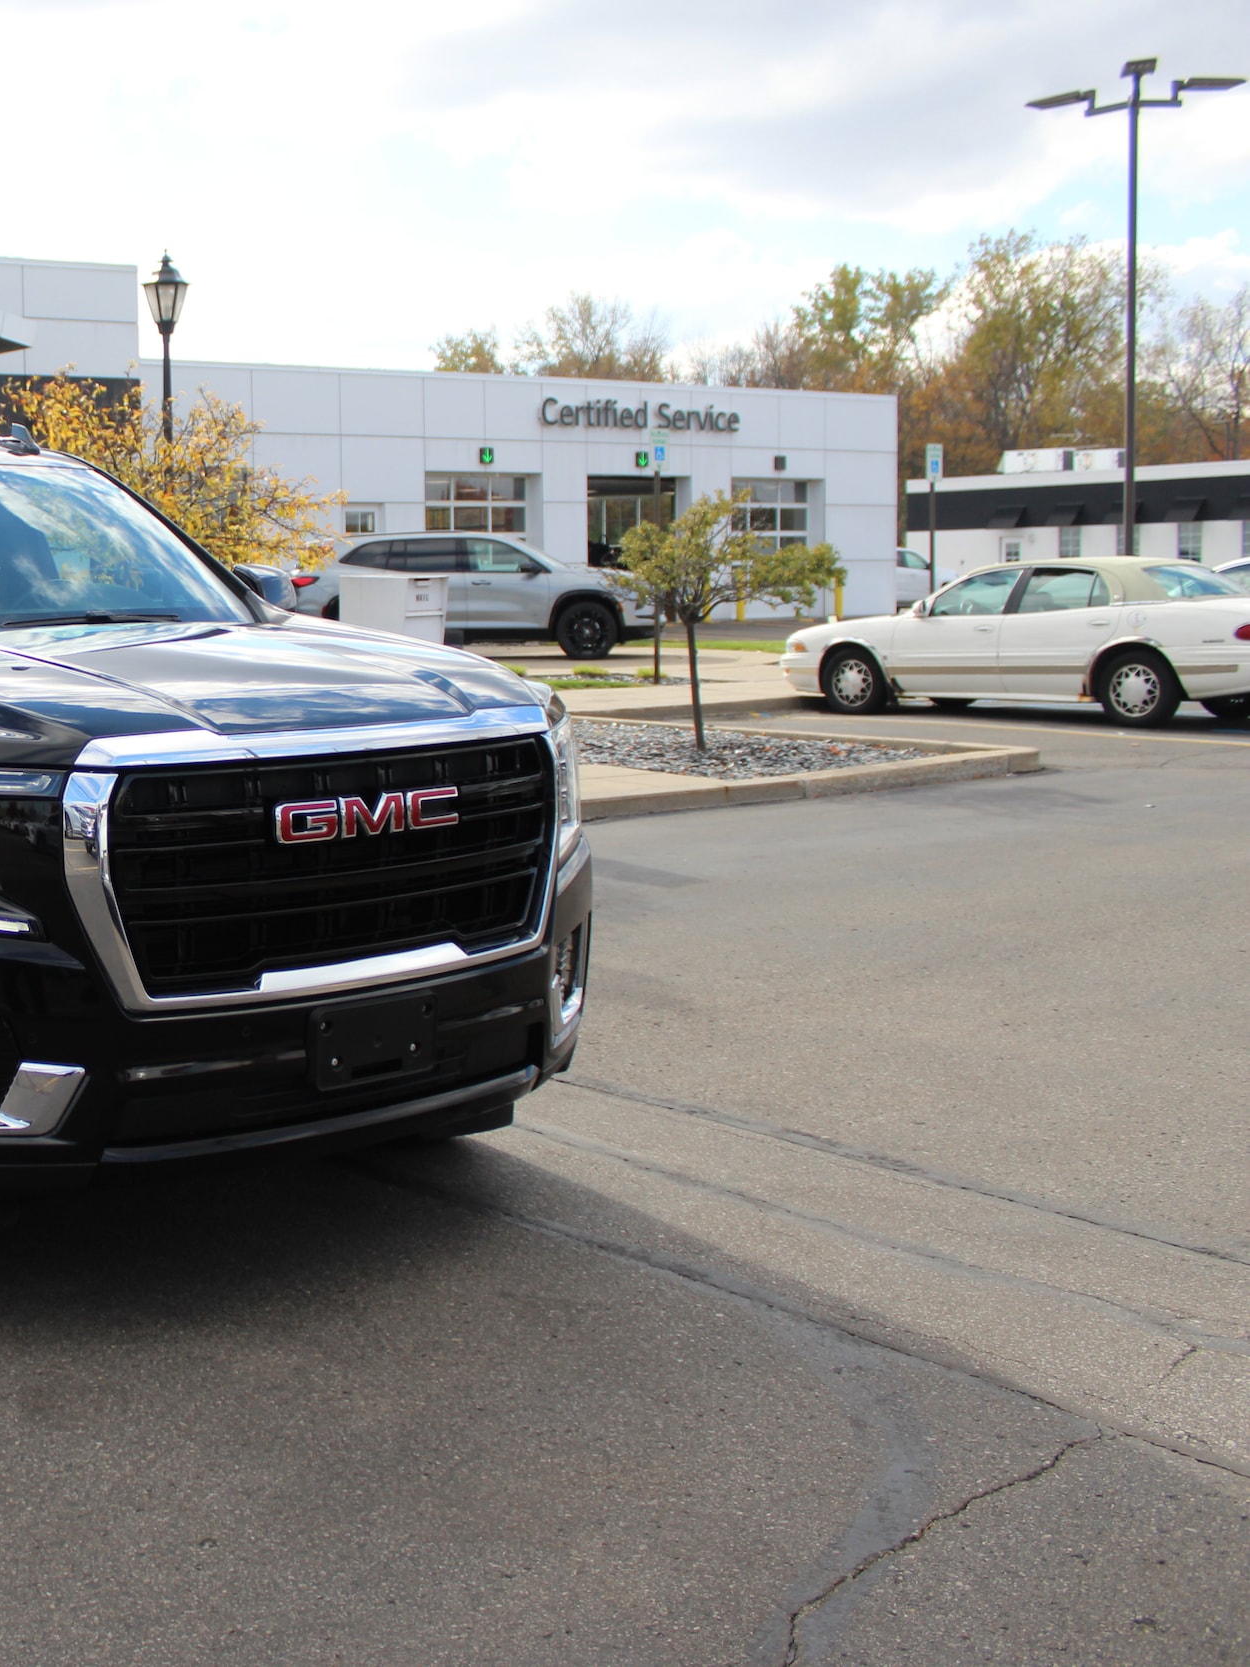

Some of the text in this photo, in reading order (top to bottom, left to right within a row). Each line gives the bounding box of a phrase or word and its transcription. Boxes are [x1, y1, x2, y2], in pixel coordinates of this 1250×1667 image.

[541, 397, 741, 432] Certified Service
[275, 785, 460, 844] GMC
